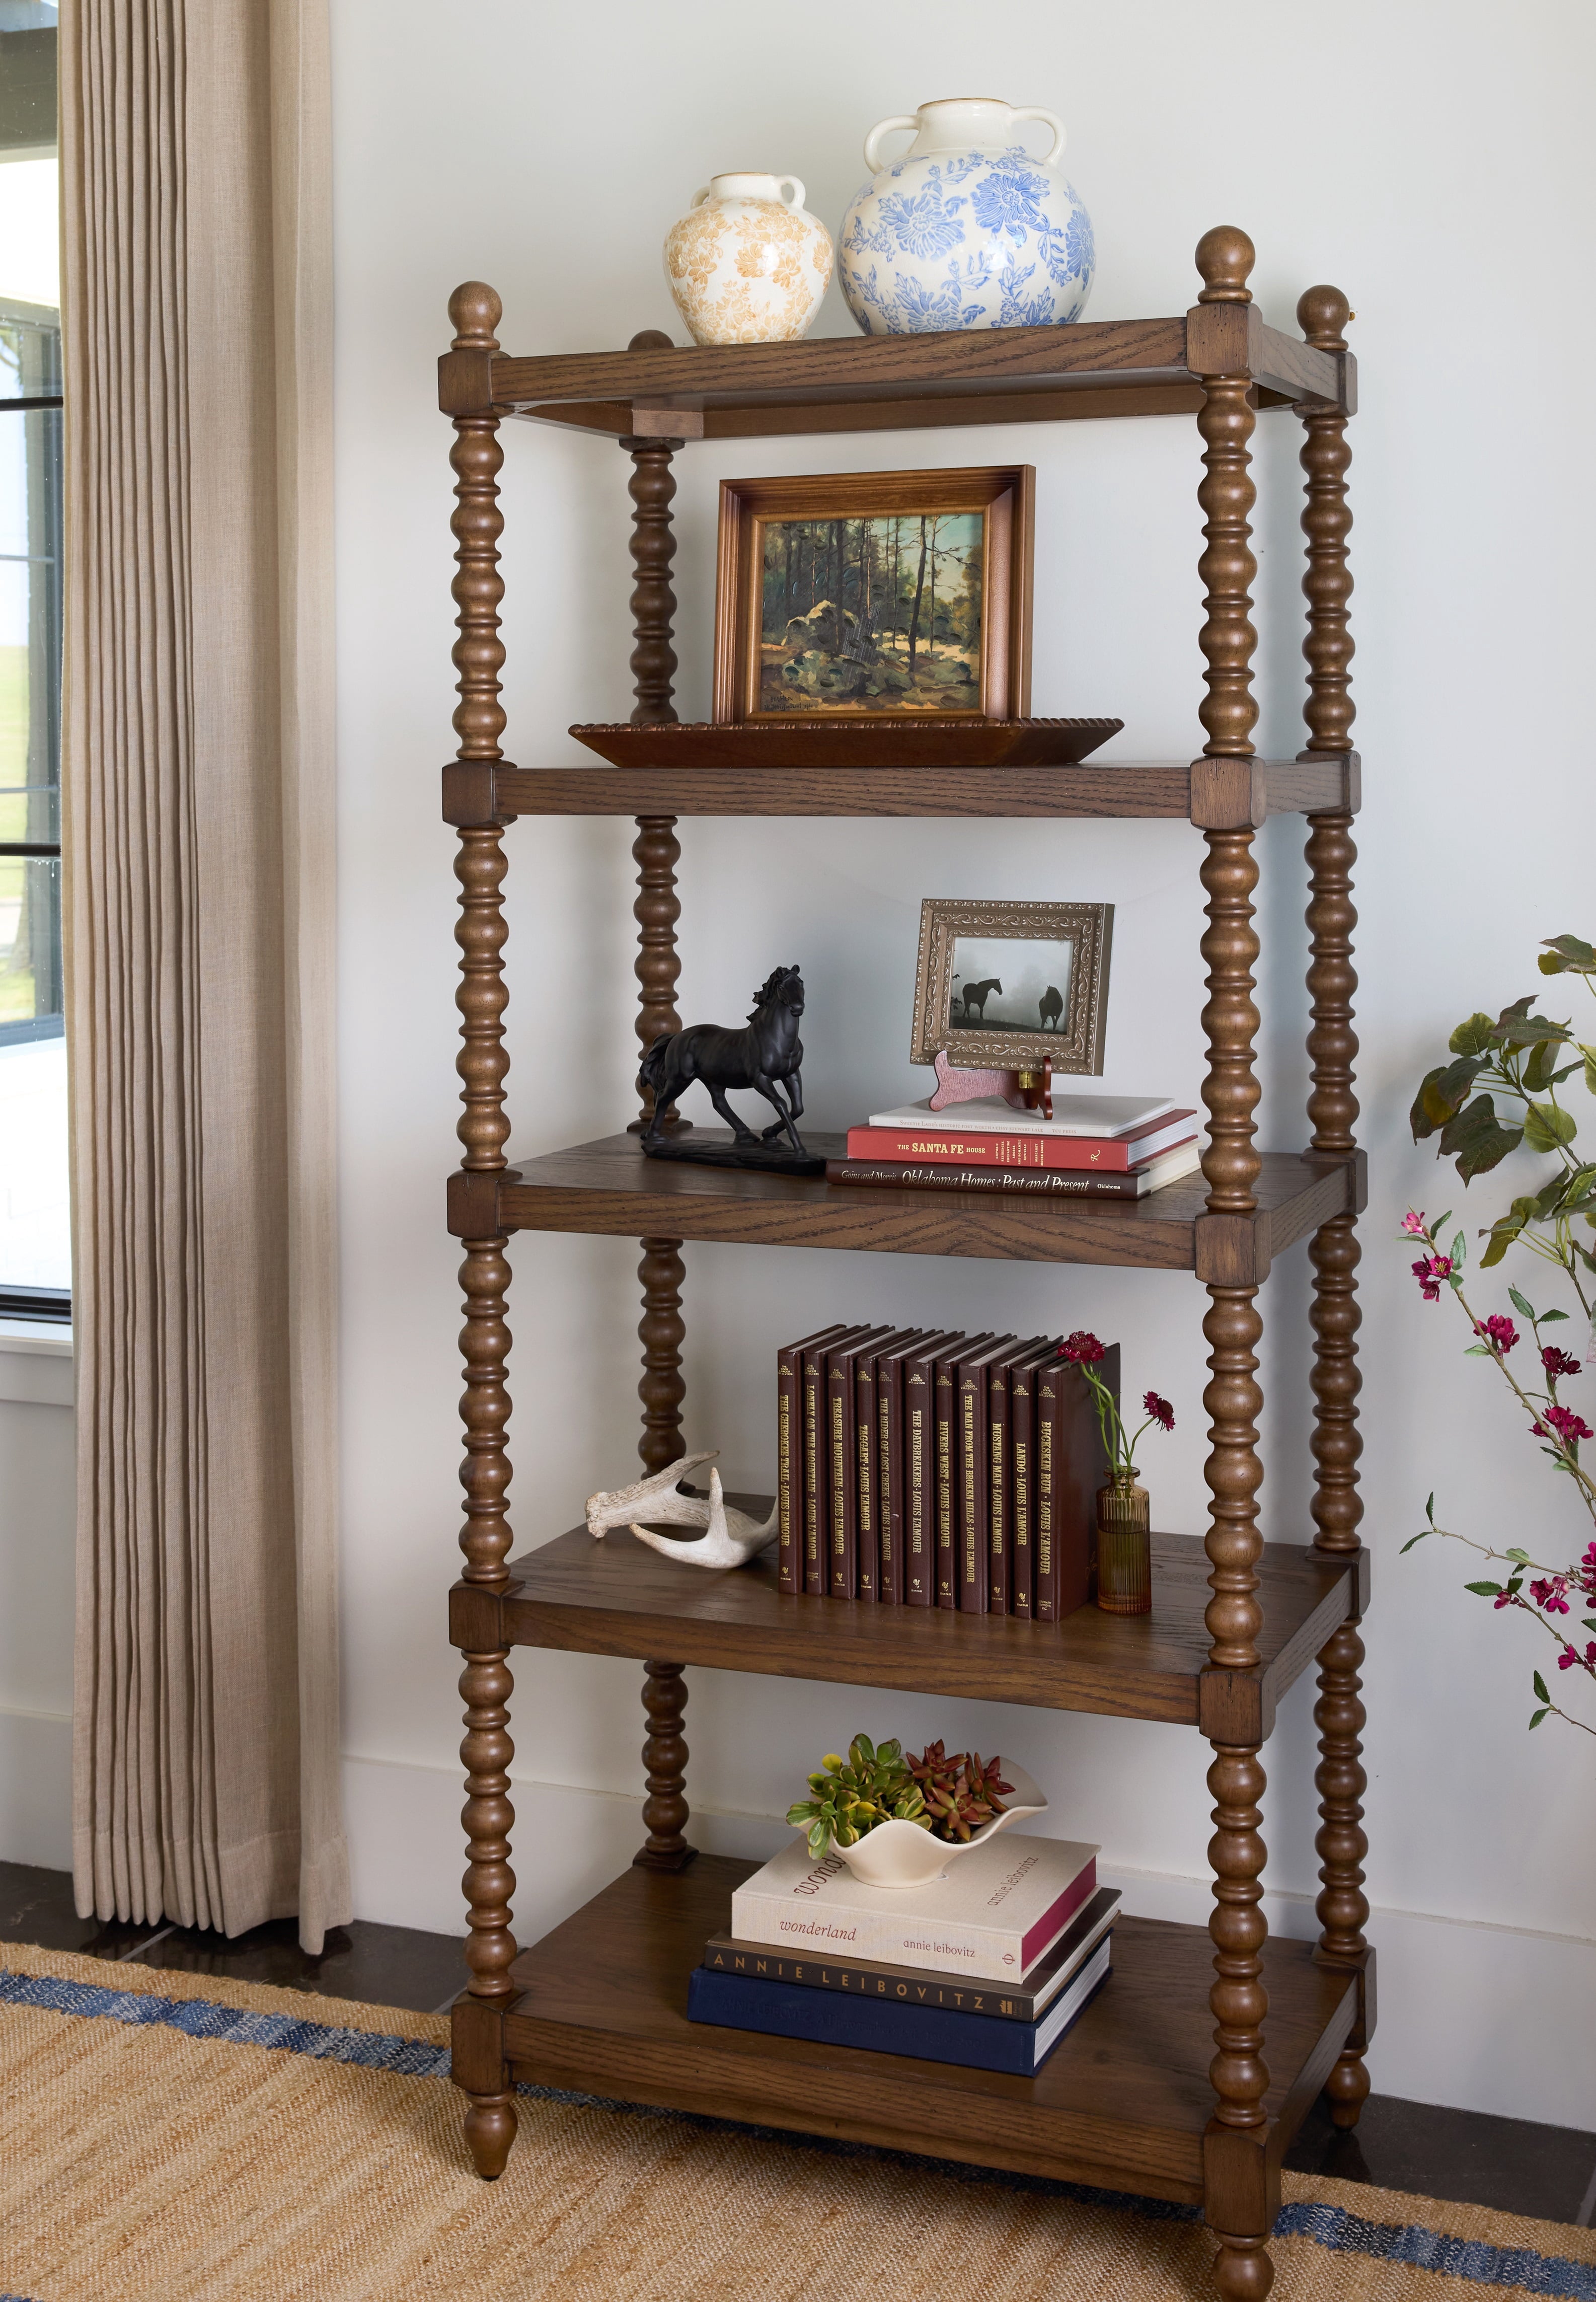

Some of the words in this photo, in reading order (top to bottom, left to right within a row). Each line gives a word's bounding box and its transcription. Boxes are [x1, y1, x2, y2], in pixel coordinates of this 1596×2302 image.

[912, 1142, 948, 1154] SANTA
[950, 1144, 963, 1154] FE
[842, 1170, 860, 1179] Goins
[860, 1171, 874, 1179] and
[876, 1172, 896, 1180] Morris
[902, 1170, 958, 1185] Oklahoma
[1003, 1174, 1025, 1188] Past
[1025, 1175, 1050, 1189] and
[1051, 1177, 1090, 1192] Present
[780, 1395, 788, 1412] THE
[964, 1395, 972, 1410] THE
[807, 1418, 815, 1429] ON
[833, 1397, 842, 1440] TREASURE
[880, 1416, 888, 1439] RIDER
[913, 1410, 921, 1427] THE
[780, 1413, 789, 1456] CHEROKEE
[807, 1432, 815, 1448] THE
[859, 1425, 868, 1464] TAGGART
[881, 1440, 888, 1451] OF
[939, 1421, 948, 1453] RIVERS
[965, 1431, 973, 1452] FROM
[993, 1423, 1002, 1463] MUSTANG
[1041, 1421, 1051, 1471] BUCKSKIN
[781, 1458, 789, 1482] TRAIL
[807, 1448, 815, 1493] MOUNTAIN
[834, 1442, 843, 1487] MOUNTAIN
[881, 1451, 889, 1471] LOST
[913, 1429, 921, 1488] DAYBREAKERS
[940, 1455, 949, 1479] WEST
[1016, 1443, 1026, 1473] LANDO
[860, 1466, 869, 1492] LOUIS
[881, 1472, 889, 1498] CREEK
[965, 1470, 973, 1500] BROKEN
[993, 1465, 1002, 1485] MAN
[1041, 1473, 1050, 1494] RUN
[781, 1485, 789, 1510] LOUIS
[834, 1491, 843, 1516] LOUIS
[913, 1490, 921, 1516] LOUIS
[940, 1482, 949, 1509] LOUIS
[993, 1489, 1002, 1515] LOUIS
[1017, 1478, 1026, 1504] LOUIS
[808, 1499, 816, 1523] LOUIS
[861, 1494, 870, 1530] L'AMOUR
[882, 1500, 890, 1525] LOUIS
[966, 1501, 974, 1523] HILLS
[1040, 1501, 1050, 1530] LOUIS
[781, 1510, 790, 1546] L'AMOUR
[835, 1518, 844, 1554] L'AMOUR
[913, 1517, 921, 1553] L'AMOUR
[940, 1510, 950, 1547] L'AMOUR
[966, 1526, 974, 1549] LOUIS
[993, 1517, 1002, 1554] L'AMOUR
[1017, 1507, 1026, 1545] L'AMOUR
[808, 1524, 816, 1560] L'AMOUR
[882, 1526, 891, 1561] L'AMOUR
[1040, 1531, 1050, 1575] L'AMOUR
[966, 1550, 974, 1583] L'AMOUR
[987, 1887, 1012, 1906] annie
[1001, 1857, 1039, 1886] leibovitz
[780, 1921, 856, 1941] wonderland
[903, 1941, 931, 1951] annie
[933, 1942, 975, 1957] leibovitz
[714, 1955, 803, 1978] ANNIE
[822, 1971, 983, 2009] LEIBOVITZ
